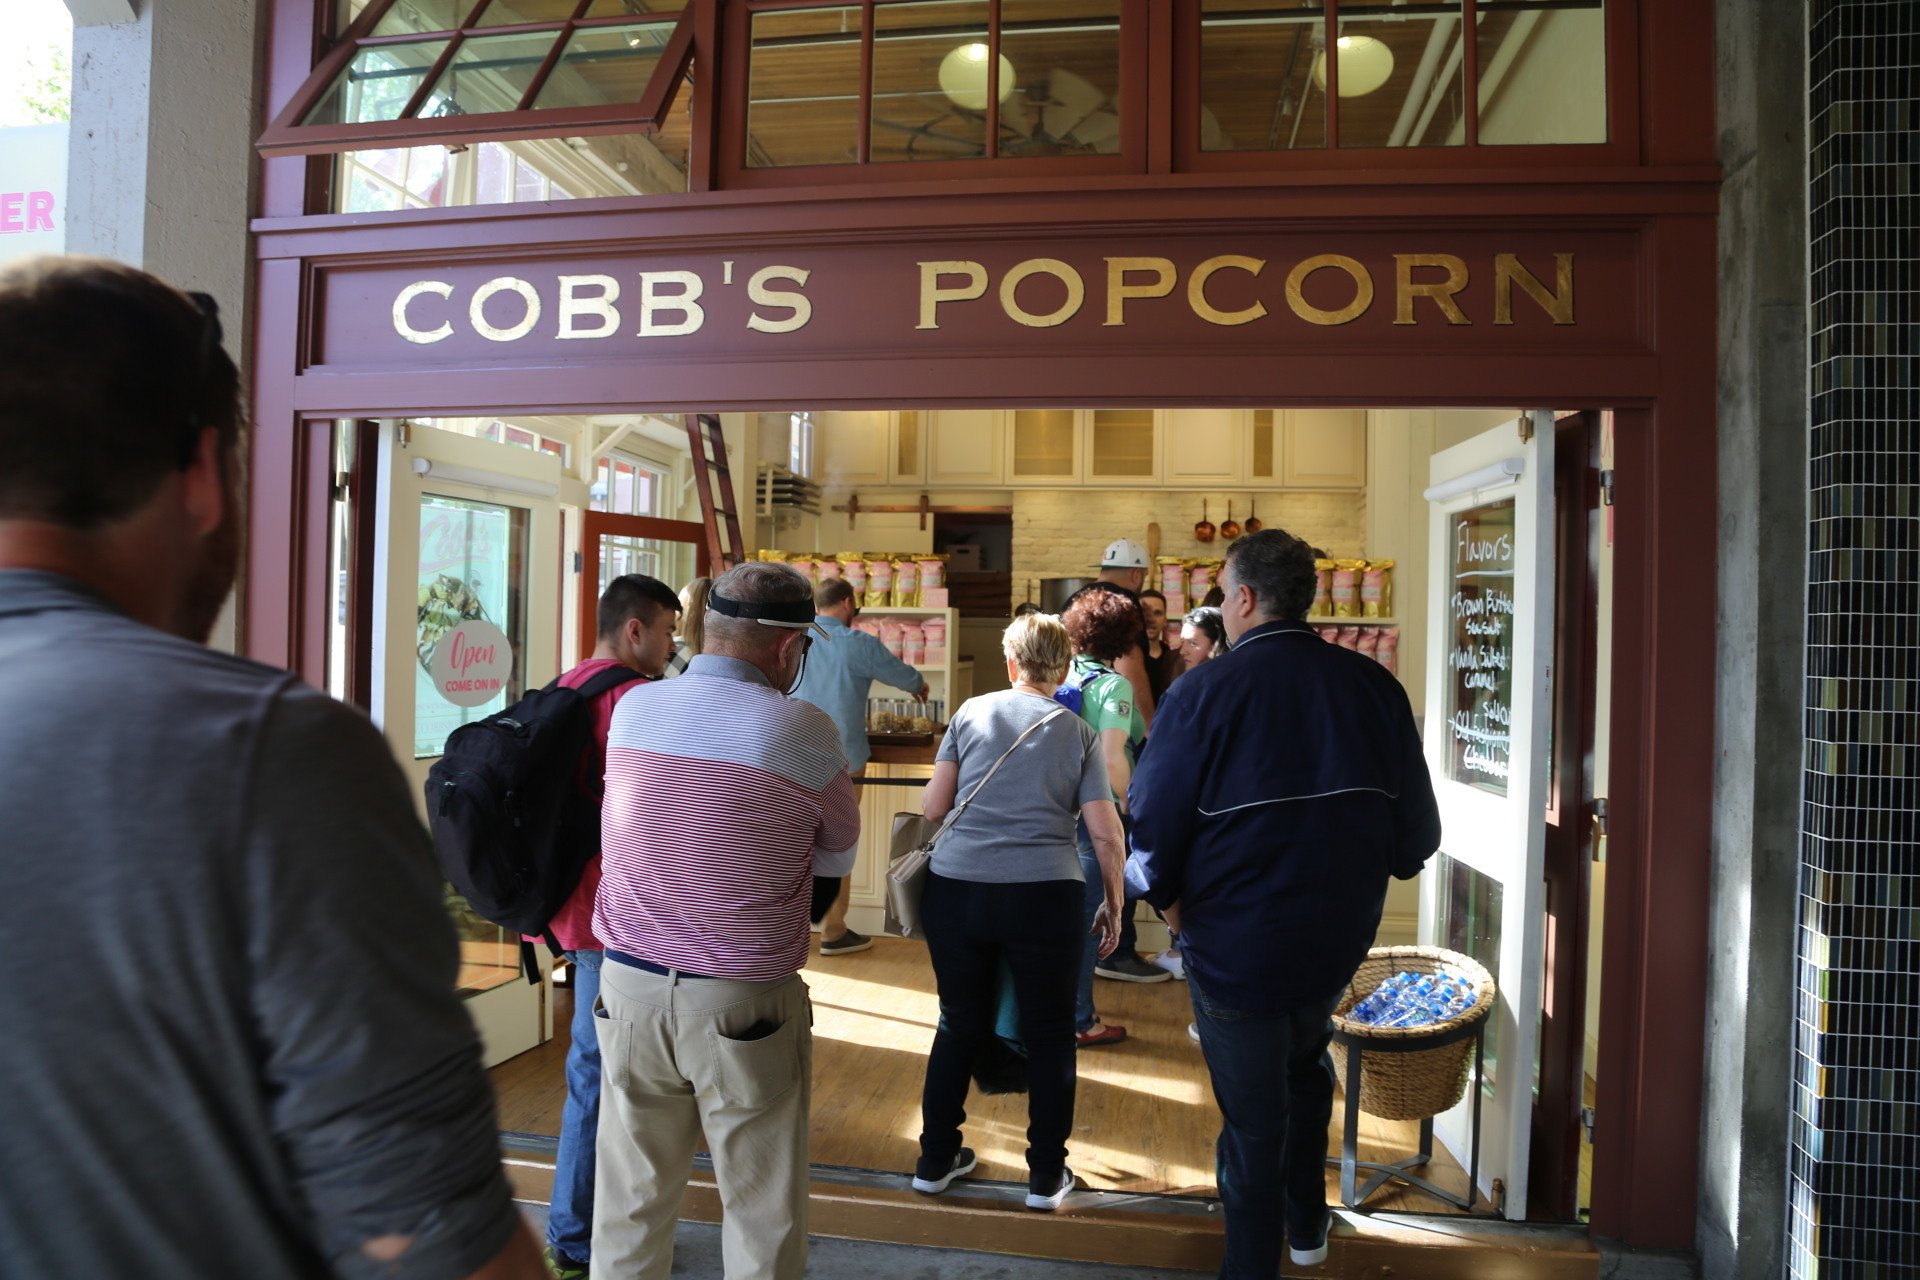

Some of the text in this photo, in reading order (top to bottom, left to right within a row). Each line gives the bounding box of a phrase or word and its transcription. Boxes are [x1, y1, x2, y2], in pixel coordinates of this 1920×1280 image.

[0, 190, 56, 233] ER
[392, 252, 1577, 345] COBB'S POPCORN
[1456, 520, 1512, 564] Flavors
[1486, 587, 1514, 617] Butte
[451, 631, 496, 678] Open
[446, 678, 500, 693] COME ON IN
